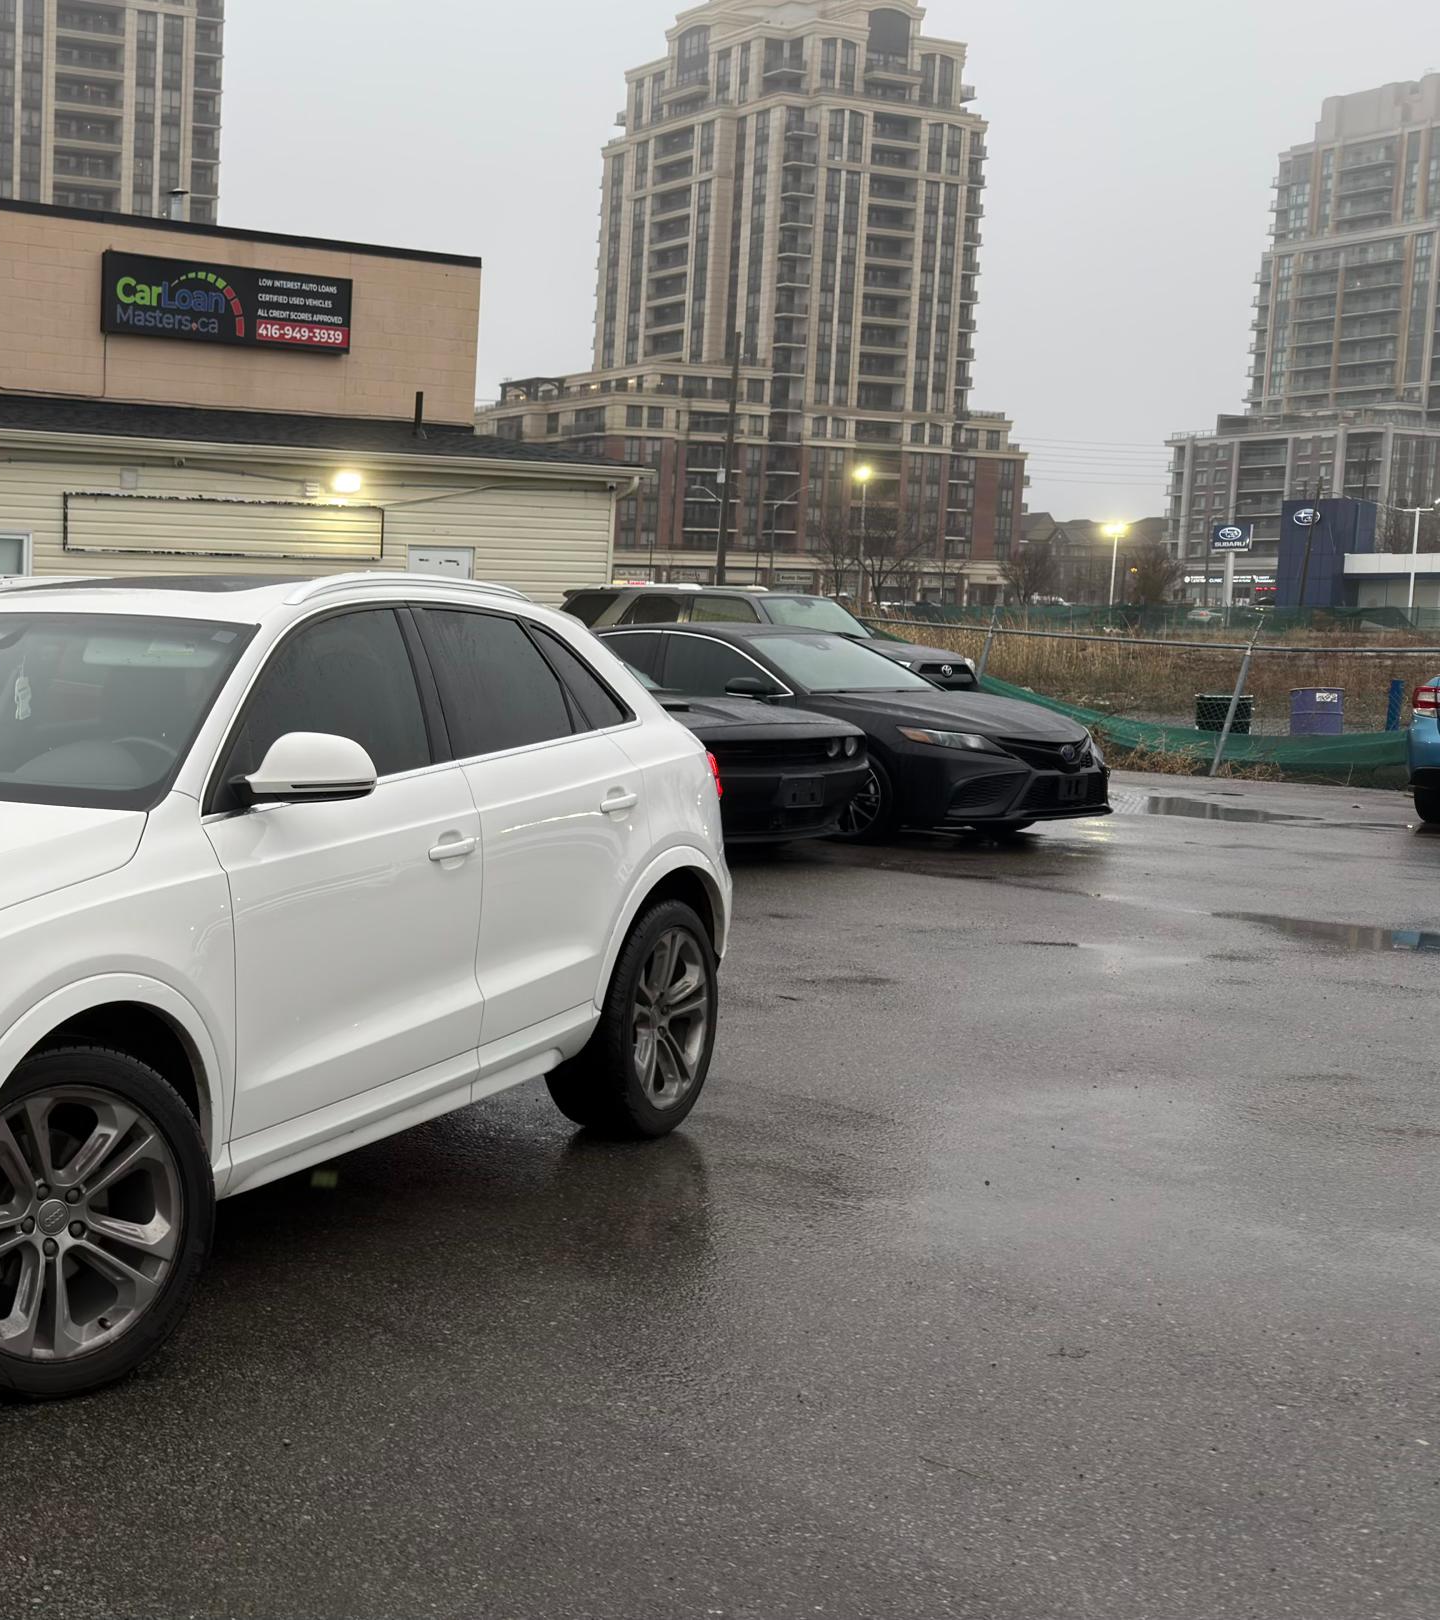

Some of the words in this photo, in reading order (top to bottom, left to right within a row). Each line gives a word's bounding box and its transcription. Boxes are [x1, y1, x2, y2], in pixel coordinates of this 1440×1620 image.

[258, 278, 273, 287] LOW
[273, 280, 301, 290] INTEREST
[301, 283, 318, 292] AUTO
[318, 285, 338, 294] LOANS
[257, 293, 288, 304] CERTIFIED
[288, 296, 305, 306] USED
[305, 298, 333, 308] VEHICLES
[257, 308, 268, 317] ALL
[268, 310, 290, 319] CREDIT
[289, 311, 313, 321] SCORES
[312, 314, 343, 324] APPROVED
[258, 323, 343, 344] 416-949-3939
